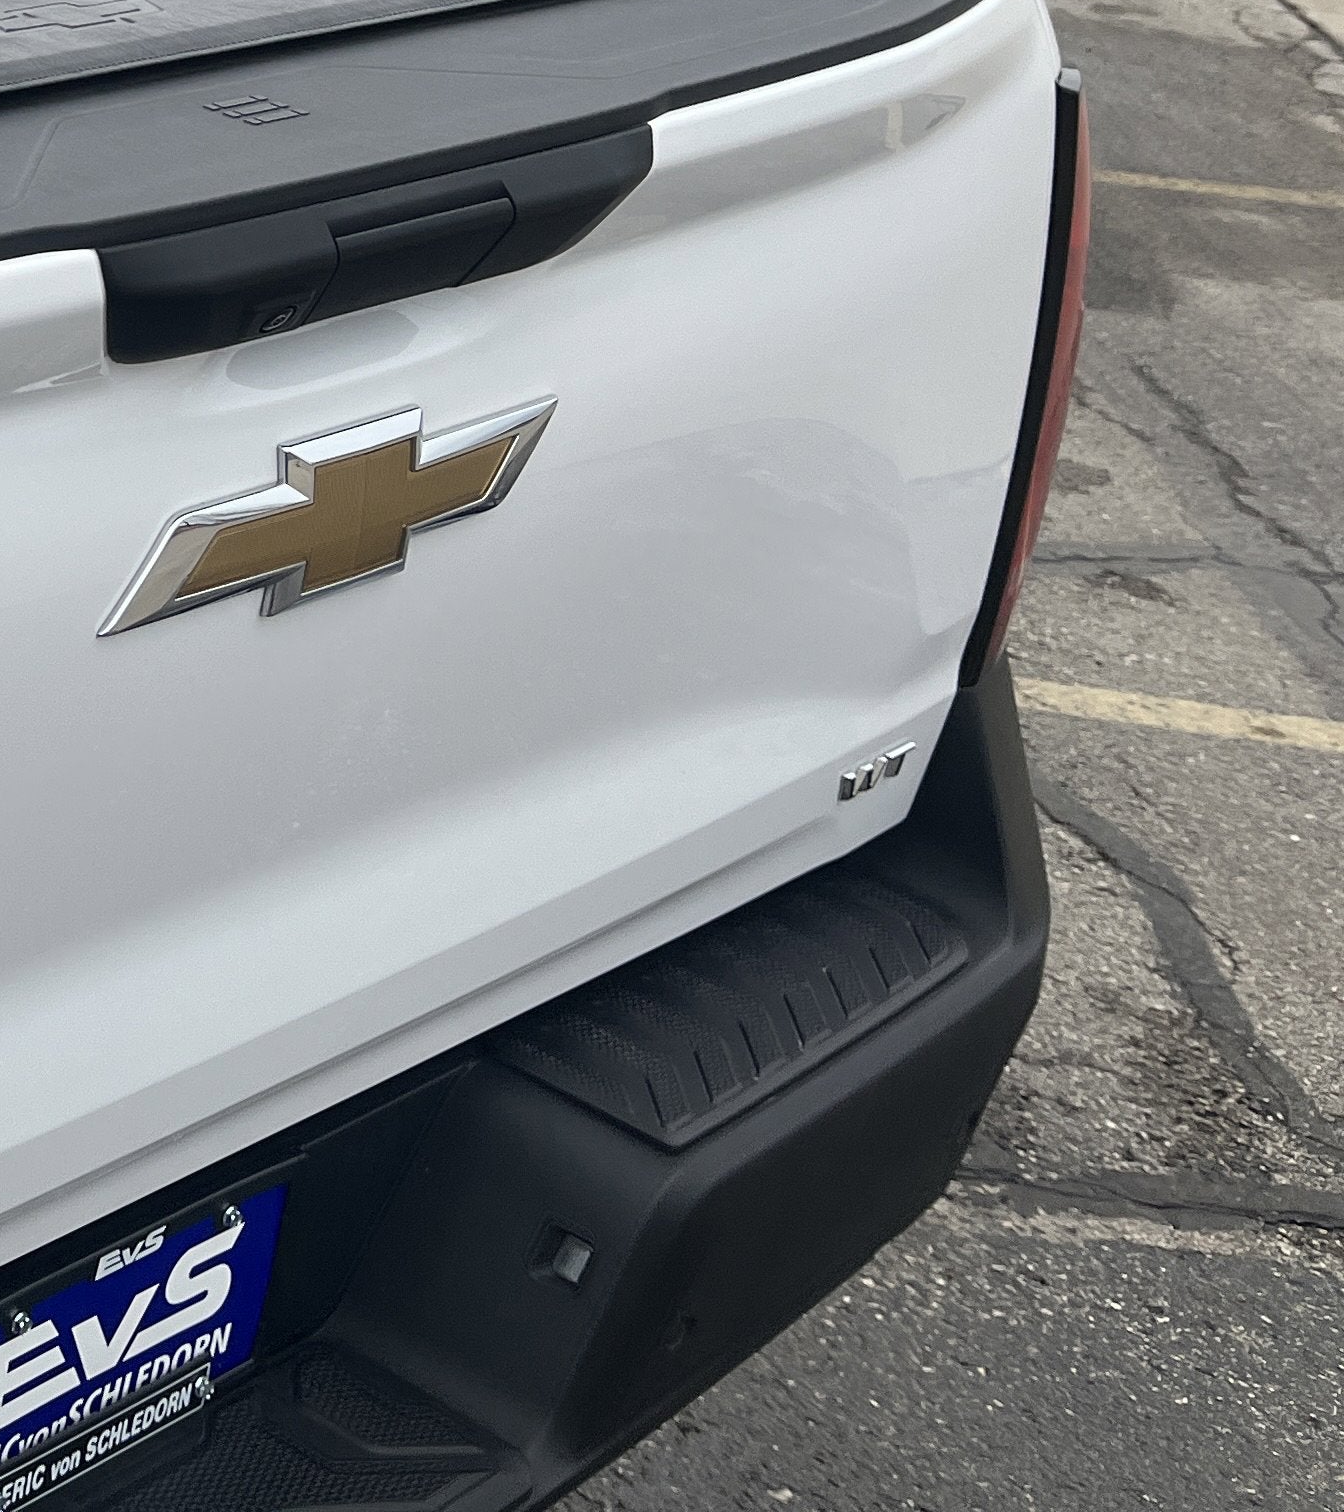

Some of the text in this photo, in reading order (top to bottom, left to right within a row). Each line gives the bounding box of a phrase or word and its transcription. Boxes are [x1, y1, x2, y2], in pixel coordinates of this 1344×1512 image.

[837, 741, 916, 801] WT
[51, 1450, 81, 1481] von
[85, 1383, 193, 1463] SCHLEDORN
